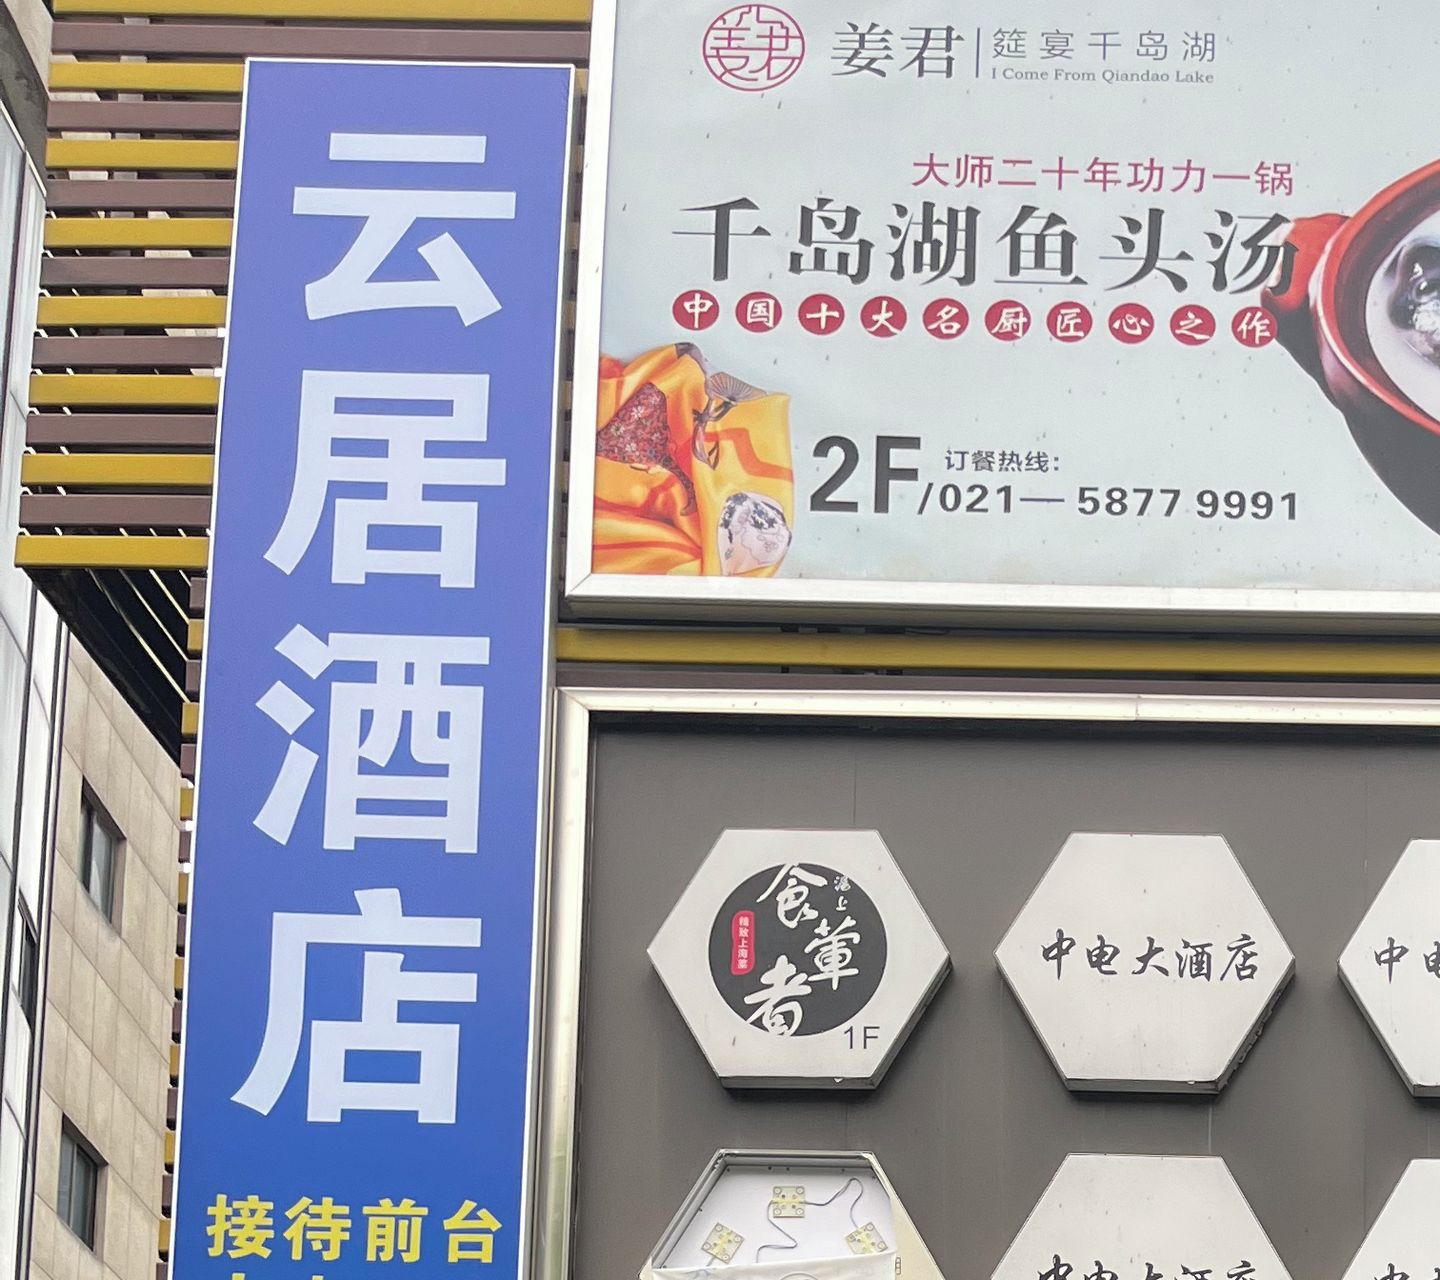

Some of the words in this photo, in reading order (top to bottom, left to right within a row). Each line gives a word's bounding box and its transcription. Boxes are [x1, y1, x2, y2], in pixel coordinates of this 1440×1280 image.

[831, 21, 965, 79] 姜君
[992, 28, 1217, 63] 筵宴千岛湖
[991, 67, 997, 80] I
[1002, 67, 1049, 81] Come
[1053, 68, 1097, 82] From
[1101, 68, 1170, 85] Qiandao
[1175, 70, 1214, 84] Lake
[910, 152, 1295, 197] 大师二十年功力一锅
[671, 196, 1300, 295] 千岛湖鱼头汤
[675, 293, 1277, 347] 中国十大名厨匠心之作
[809, 434, 923, 515] 2F
[944, 449, 1060, 474] 订餐热线：
[1077, 486, 1182, 518] 5877
[1196, 489, 1297, 521] 9991
[230, 131, 517, 1126] 云居酒店
[1040, 928, 1260, 982] 中电大酒店
[843, 1025, 881, 1050] 1F
[205, 1193, 503, 1264] 接待前台
